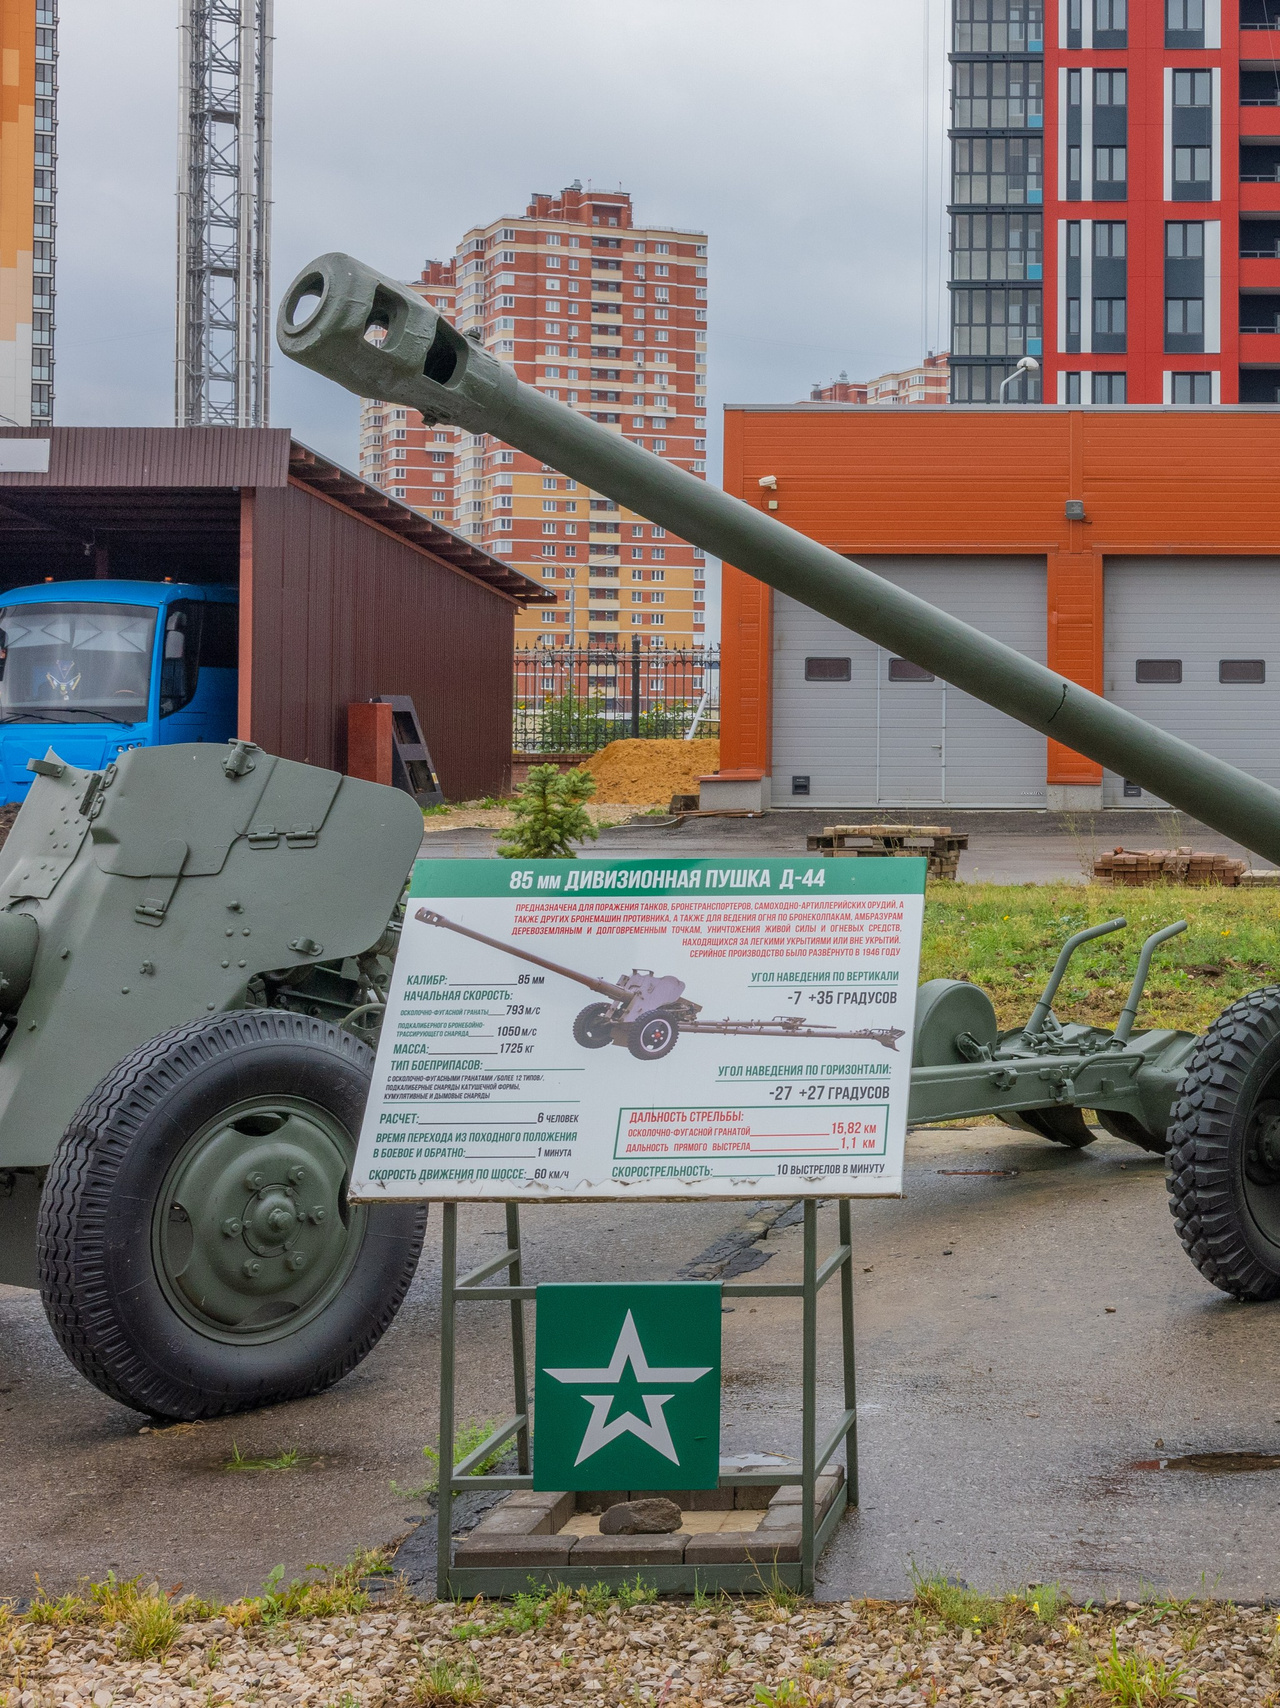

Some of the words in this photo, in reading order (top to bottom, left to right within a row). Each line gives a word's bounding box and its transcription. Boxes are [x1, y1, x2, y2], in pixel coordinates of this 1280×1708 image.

[509, 870, 534, 890] 85
[564, 870, 701, 891] ДИВИЗИОННАЯ
[705, 869, 771, 888] ПУШКА
[779, 868, 825, 890] Д-44
[515, 903, 577, 913] ПРЕДНАЗНАЧЕНА
[578, 903, 594, 912] ДЛЯ
[595, 903, 639, 911] ПОРАЖЕНИЯ
[754, 900, 866, 910] САМОХОДНО-АРТИЛЛЕРИЙСКИХ
[899, 901, 904, 909] А
[514, 915, 539, 923] ТАКЖЕ
[540, 915, 569, 924] ДРУГИХ
[570, 915, 621, 923] БРОНЕМАШИН
[673, 914, 678, 922] А
[680, 914, 704, 922] ТАКЖЕ
[706, 914, 722, 922] ДЛЯ
[723, 914, 756, 922] ВЕДЕНИЯ
[758, 914, 776, 922] ОГНЯ
[854, 912, 903, 920] АМБРАЗУРАМ
[511, 927, 582, 936] ДЕРЕВОЗЕМЛЯНЫМ
[596, 926, 667, 936] ДОЛГОВРЕМЕННЫМ
[707, 926, 760, 934] УНИЧТОЖЕНИЯ
[765, 924, 791, 933] ЖИВОЙ
[795, 924, 816, 933] СИЛЫ
[820, 924, 826, 932] И
[830, 924, 864, 932] ОГНЕВЫХ
[682, 938, 738, 947] НАХОДЯЩИХСЯ
[739, 938, 749, 946] ЗА
[750, 937, 785, 945] ЛЕГКИМИ
[786, 937, 831, 945] УКРЫТИЯМИ
[850, 936, 863, 944] ВНЕ
[690, 948, 726, 958] СЕРИЙНОЕ
[728, 949, 784, 958] ПРОИЗВОДСТВО
[808, 947, 854, 956] РАЗВЁРНУТО
[855, 948, 860, 956] В
[862, 948, 880, 956] 1946
[881, 948, 901, 957] ГОДУ
[518, 974, 530, 985] 85
[751, 972, 775, 982] УГОЛ
[776, 971, 830, 982] НАВЕДЕНИЯ
[832, 971, 844, 981] ПО
[846, 970, 899, 981] ВЕРТИКАЛИ
[403, 990, 462, 1001] НАЧАЛЬНАЯ
[787, 991, 802, 1005] -7
[808, 990, 834, 1005] +35
[836, 991, 897, 1005] ГРАДУСОВ
[506, 1005, 524, 1015] 793
[396, 1030, 443, 1038] ТРАССИРУЮЩЕГО
[497, 1026, 520, 1036] 1050
[500, 1043, 523, 1054] 1725
[391, 1060, 410, 1071] ТИП
[718, 1066, 743, 1077] УГОЛ
[745, 1065, 804, 1076] НАВЕДЕНИЯ
[805, 1064, 818, 1075] ПО
[493, 1074, 514, 1082] /БОЛЕЕ
[386, 1084, 433, 1092] ПОДКАЛИБЕРНЫЕ
[769, 1086, 792, 1100] -27
[798, 1085, 825, 1100] +27
[828, 1086, 890, 1101] ГРАДУСОВ
[434, 1092, 463, 1100] ДЫМОВЫЕ
[537, 1112, 544, 1123] 6
[546, 1114, 579, 1123] ЧЕЛОВЕК
[629, 1112, 687, 1124] ДАЛЬНОСТЬ
[628, 1125, 712, 1138] ОСКОЛОЧНО-ФУГАСНОЙ
[714, 1124, 751, 1136] ГРАНАТОЙ
[831, 1122, 862, 1136] 15,82
[375, 1132, 406, 1143] ВРЕМЯ
[407, 1132, 453, 1144] ПЕРЕХОДА
[454, 1132, 467, 1142] ИЗ
[468, 1132, 521, 1143] ПОХОДНОГО
[522, 1131, 578, 1142] ПОЛОЖЕНИЯ
[626, 1143, 669, 1153] ДАЛЬНОСТЬ
[673, 1143, 707, 1152] ПРЯМОГО
[712, 1142, 751, 1152] ВЫСТРЕЛА
[841, 1136, 857, 1150] 1,1
[373, 1148, 379, 1158] В
[381, 1148, 414, 1158] БОЕВОЕ
[415, 1148, 423, 1158] И
[538, 1147, 542, 1157] 1
[544, 1148, 572, 1157] МИНУТА
[368, 1169, 417, 1180] СКОРОСТЬ
[418, 1169, 474, 1181] ДВИЖЕНИЯ
[476, 1168, 490, 1180] ПО
[534, 1168, 547, 1179] 60
[777, 1164, 788, 1175] 10
[791, 1164, 841, 1175] ВЫСТРЕЛОВ
[843, 1164, 849, 1174] В
[850, 1163, 885, 1174] МИНУТУ
